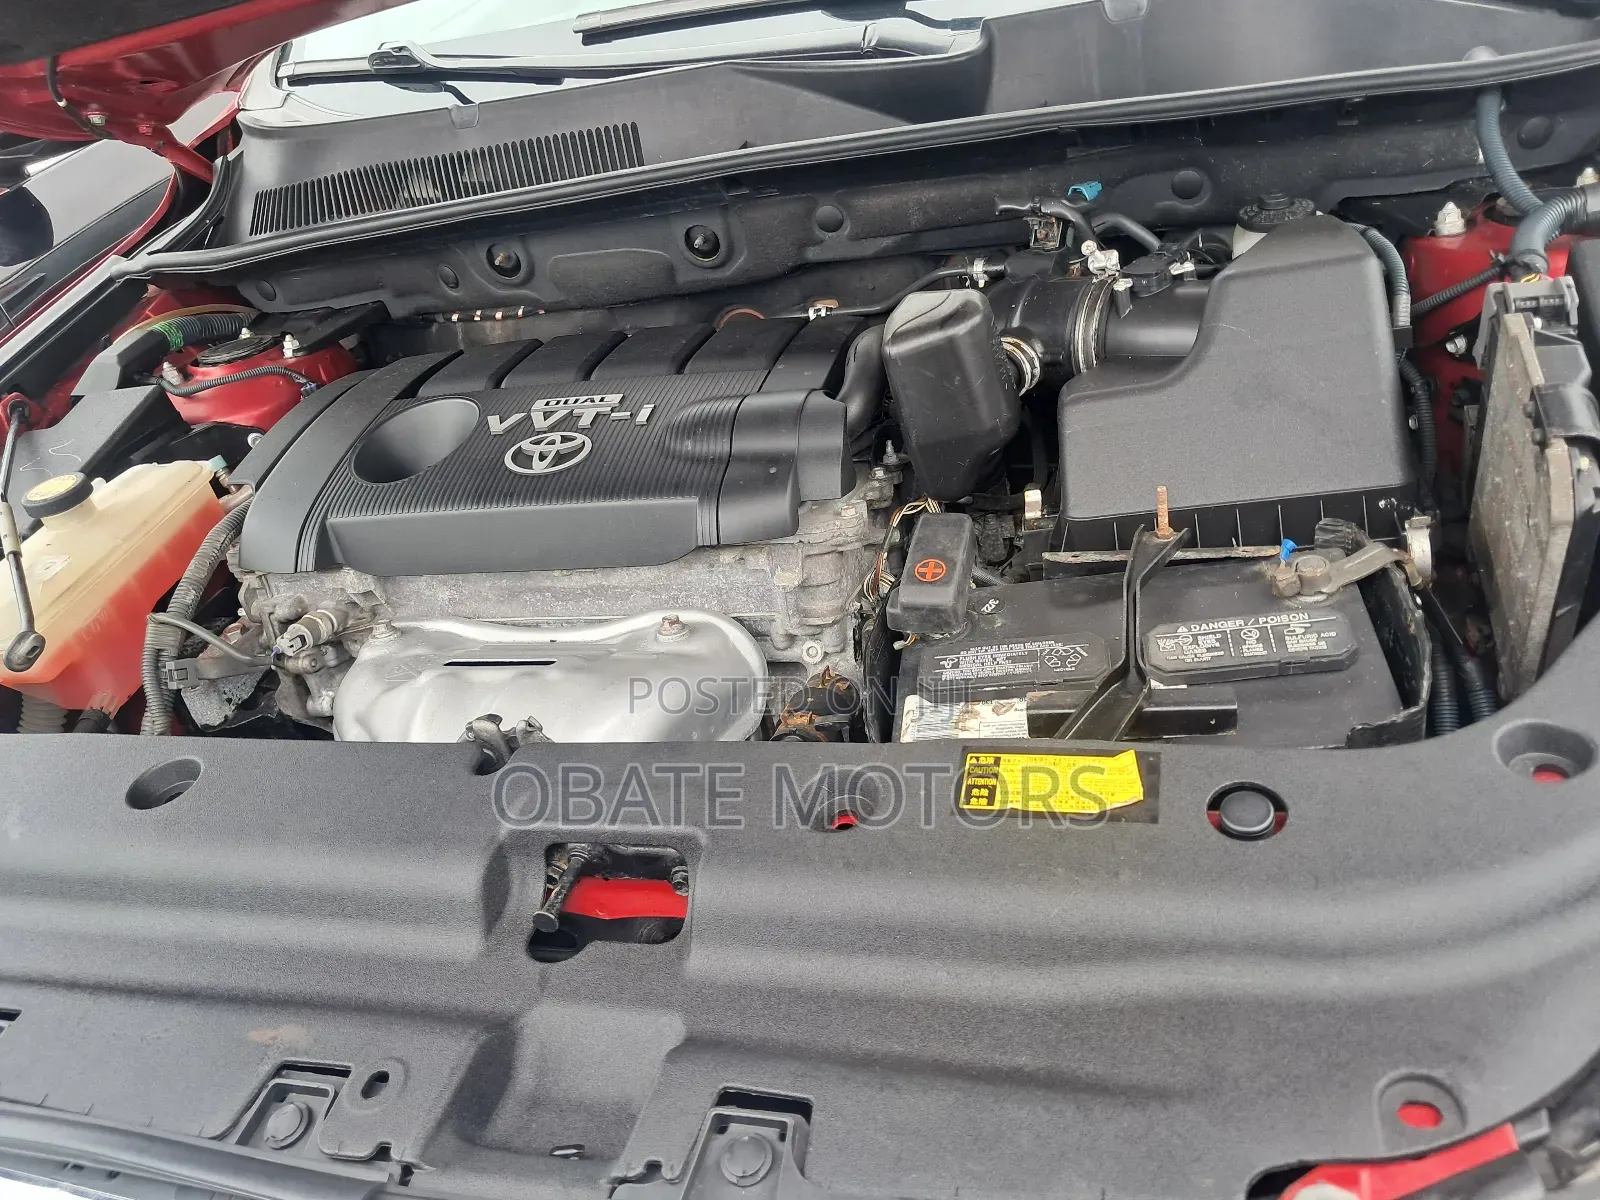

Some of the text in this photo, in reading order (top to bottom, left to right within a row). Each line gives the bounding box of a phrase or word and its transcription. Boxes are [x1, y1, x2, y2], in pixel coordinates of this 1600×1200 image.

[540, 396, 616, 408] DUAL
[1190, 613, 1309, 632] DANGER / POISON
[969, 766, 999, 774] CAUTION
[967, 778, 997, 786] ATTENTION
